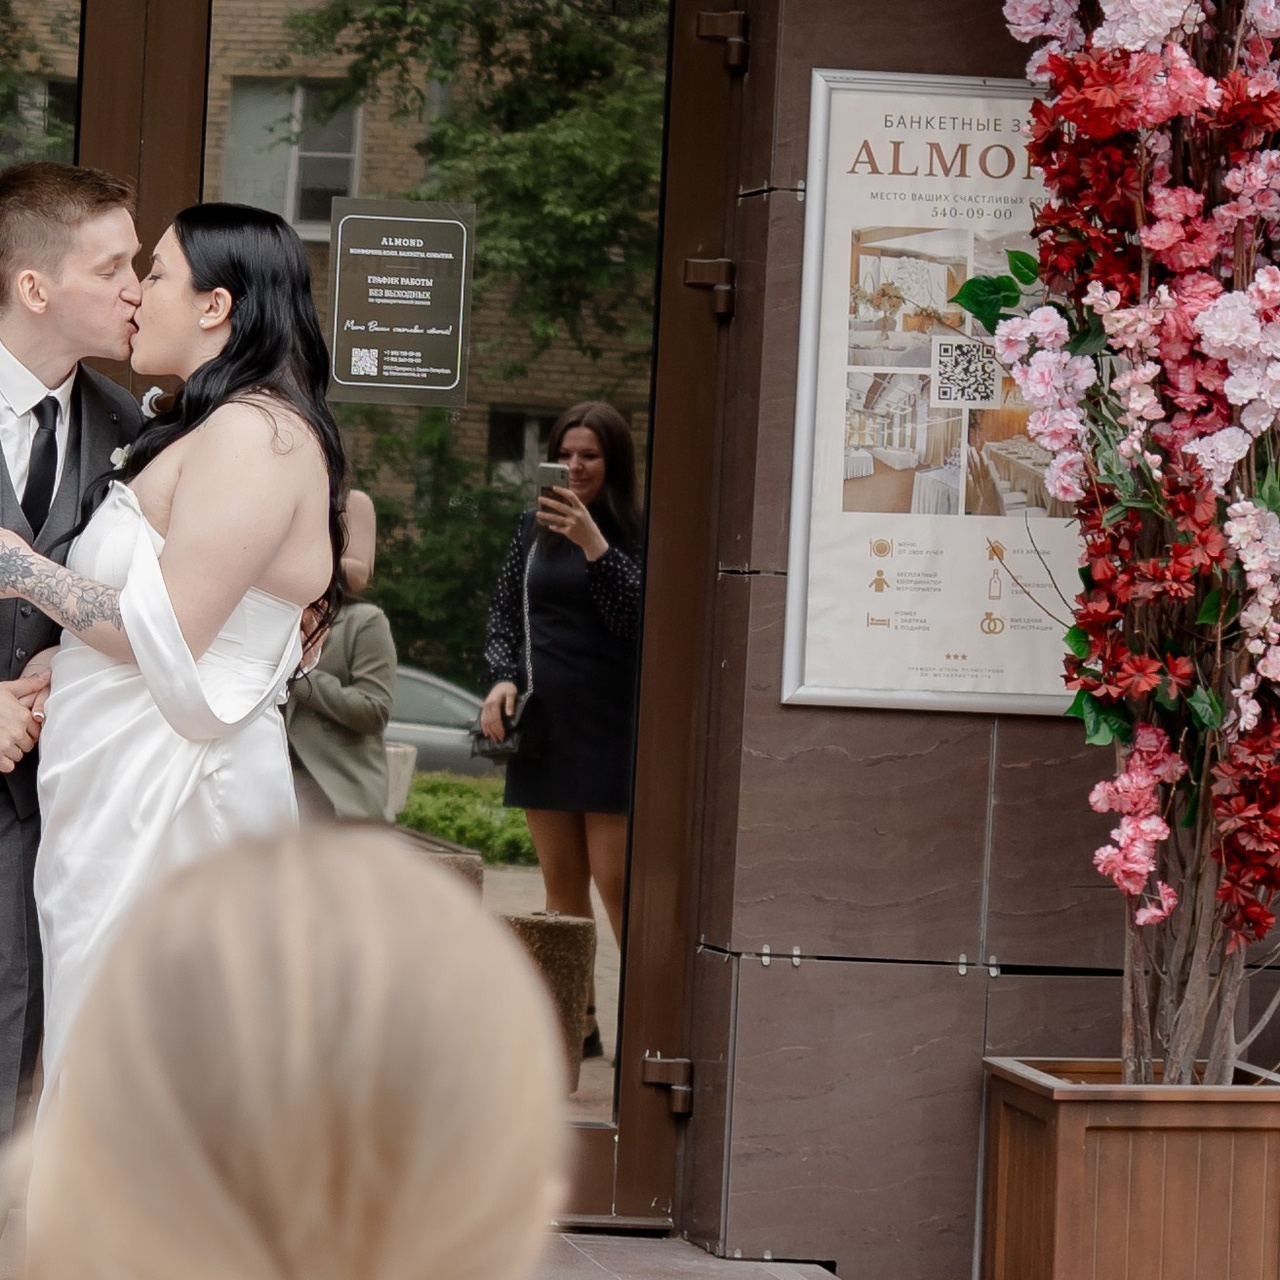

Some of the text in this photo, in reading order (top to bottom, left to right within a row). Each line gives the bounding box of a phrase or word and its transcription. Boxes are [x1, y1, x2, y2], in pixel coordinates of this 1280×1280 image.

[884, 114, 1002, 132] БАНКЕТНЫЕ
[870, 191, 907, 202] МЕСТО
[911, 193, 950, 203] ВАШИХ
[953, 194, 1024, 205] СЧАСТЛИВЫХ
[930, 206, 1013, 220] 540-09-00
[380, 236, 424, 248] ALMOND
[400, 276, 434, 287] РАБОТЫ
